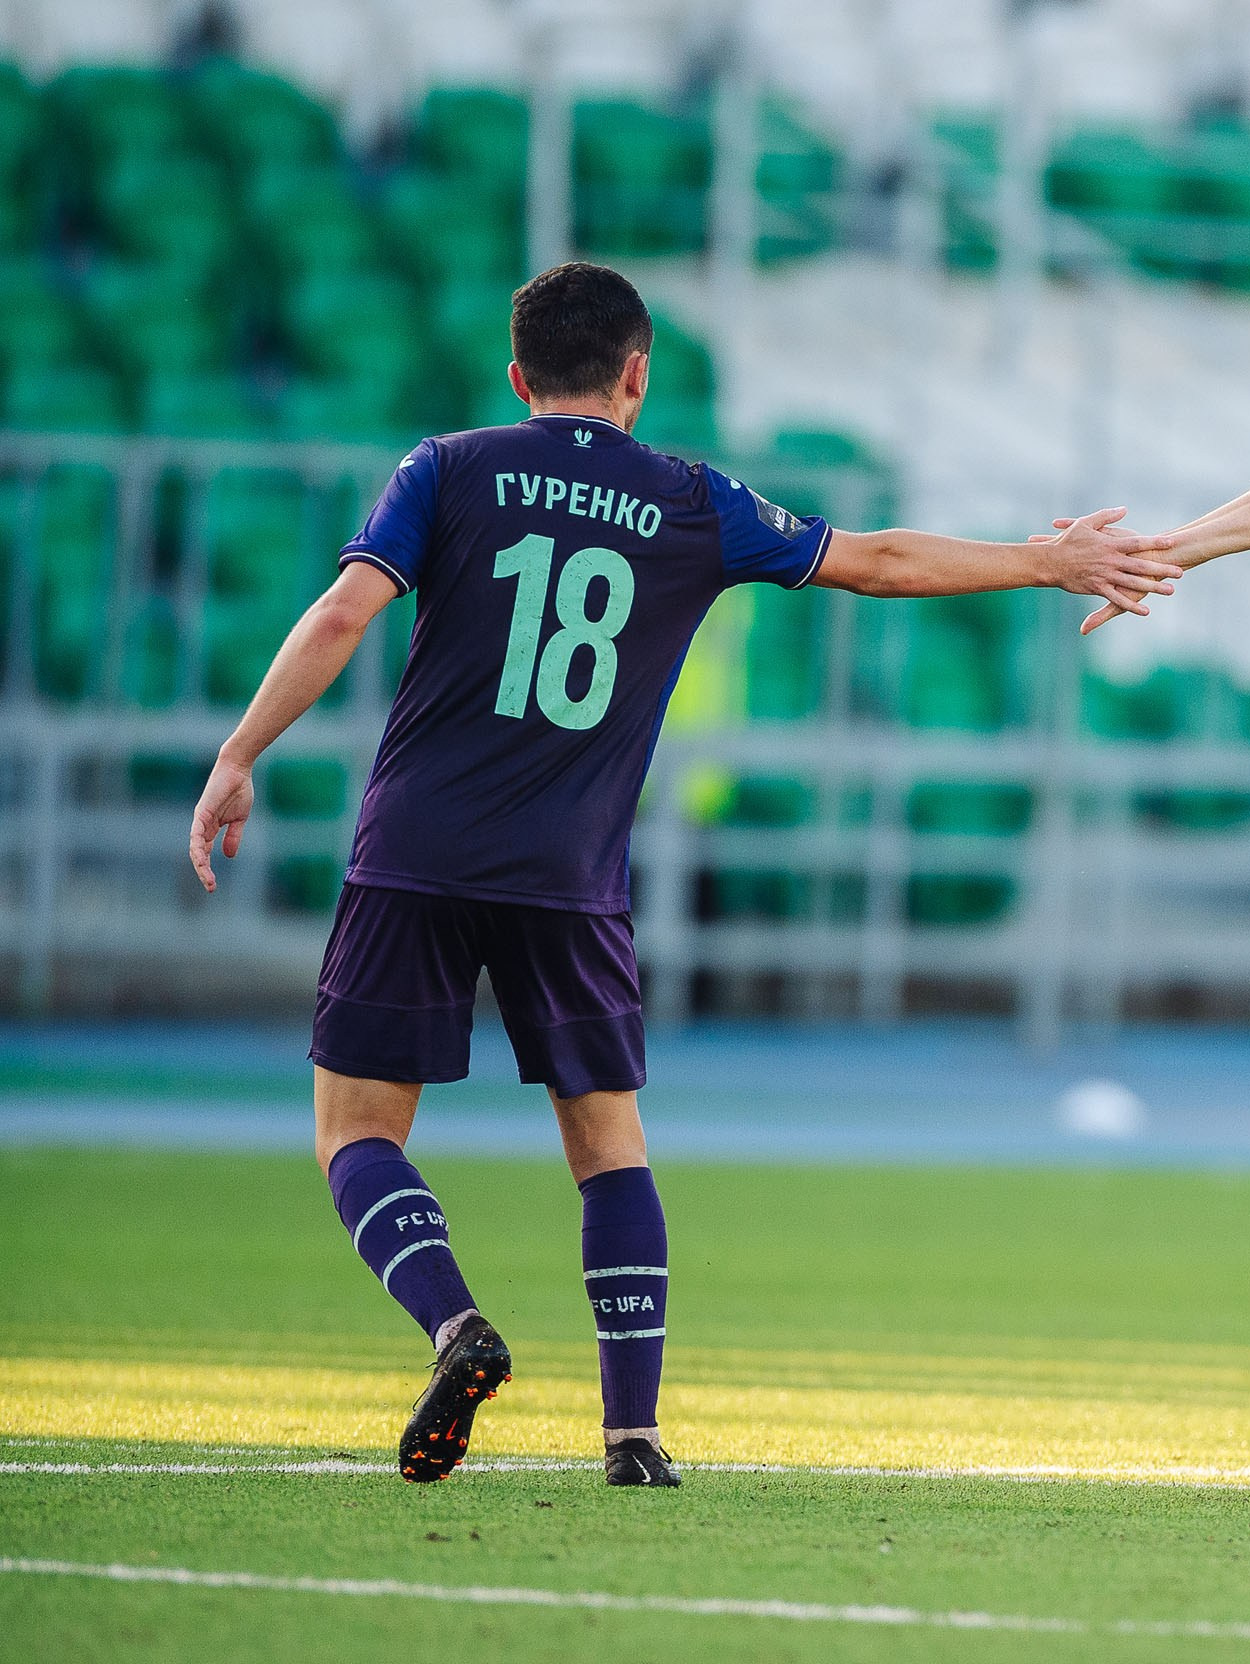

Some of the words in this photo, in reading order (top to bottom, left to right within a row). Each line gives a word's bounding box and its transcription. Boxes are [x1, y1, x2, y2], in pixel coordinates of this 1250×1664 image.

[495, 472, 662, 539] ГУРЕНКО
[492, 533, 635, 730] 18
[395, 1211, 425, 1232] FC
[616, 1295, 655, 1313] UFA
